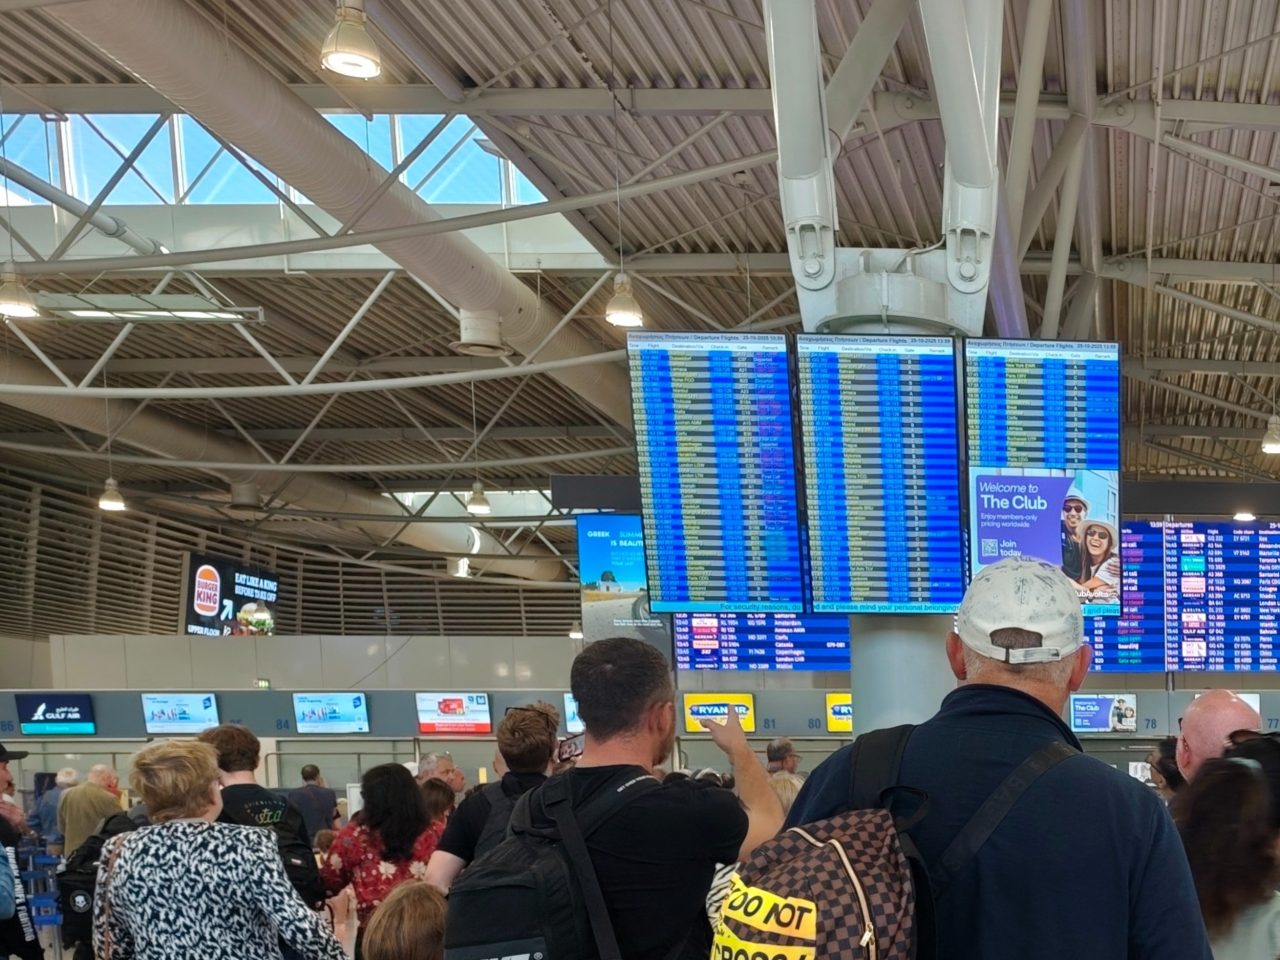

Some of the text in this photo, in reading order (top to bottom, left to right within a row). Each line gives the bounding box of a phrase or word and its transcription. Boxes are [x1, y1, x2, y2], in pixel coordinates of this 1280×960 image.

[980, 482, 1039, 493] Welcome to
[980, 494, 1048, 510] The Club
[980, 513, 1038, 523] Enjoy members-only
[981, 521, 1001, 529] pricing
[587, 530, 611, 538] GREEK
[999, 540, 1017, 548] Join
[1000, 548, 1022, 557] today
[197, 580, 218, 592] BURGER
[235, 572, 247, 585] EAT
[247, 575, 259, 587] LIKE
[263, 579, 278, 592] KING
[196, 590, 218, 605] KING
[235, 584, 277, 603] BEFORE OFF
[734, 604, 759, 612] security
[835, 604, 857, 612] please
[894, 604, 923, 612] personal
[187, 624, 221, 637] UPPER FLOOR
[699, 705, 746, 715] RYANIR
[45, 712, 81, 720] GULF AIR
[0, 720, 15, 732] 86
[276, 719, 290, 730] 84
[763, 718, 776, 729] 81
[808, 718, 821, 729] 80
[1145, 718, 1157, 729] 78
[1267, 718, 1279, 729] 77
[14, 878, 26, 904] KNIFE
[728, 891, 813, 930] DO NOT
